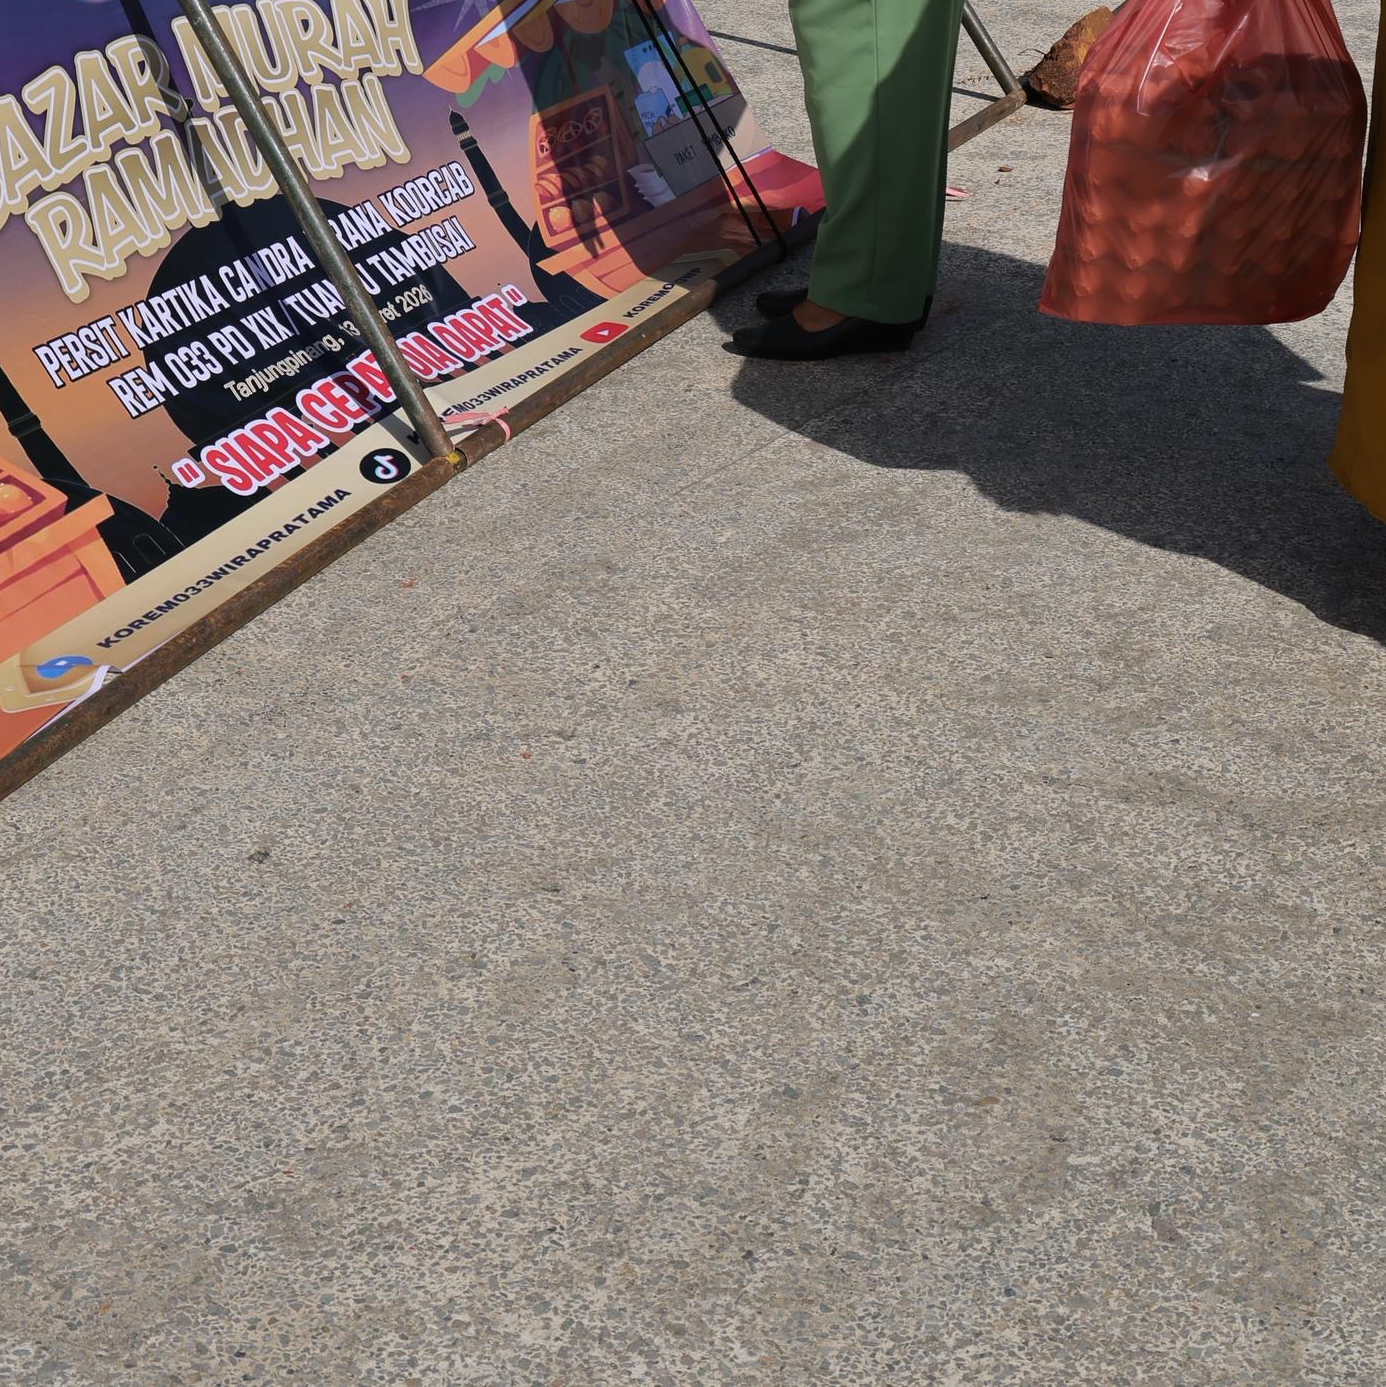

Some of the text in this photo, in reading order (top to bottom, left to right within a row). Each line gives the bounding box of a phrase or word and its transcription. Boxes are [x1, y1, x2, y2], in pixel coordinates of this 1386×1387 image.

[25, 73, 412, 303] RAMADHAN
[33, 313, 133, 389] PERSIT
[117, 273, 230, 351] KARTIKA
[217, 235, 317, 302] CANDRA
[376, 160, 477, 230] KOORCAB
[108, 366, 176, 420] REM
[164, 341, 223, 391] 033
[207, 321, 257, 366] PD
[237, 305, 295, 351] XIX
[365, 216, 474, 287] TAMBUSAI
[201, 407, 330, 497] SIAPA
[427, 294, 534, 364] DAPAT
[223, 332, 345, 403] Tanjungpinang,
[396, 284, 434, 313] 2026
